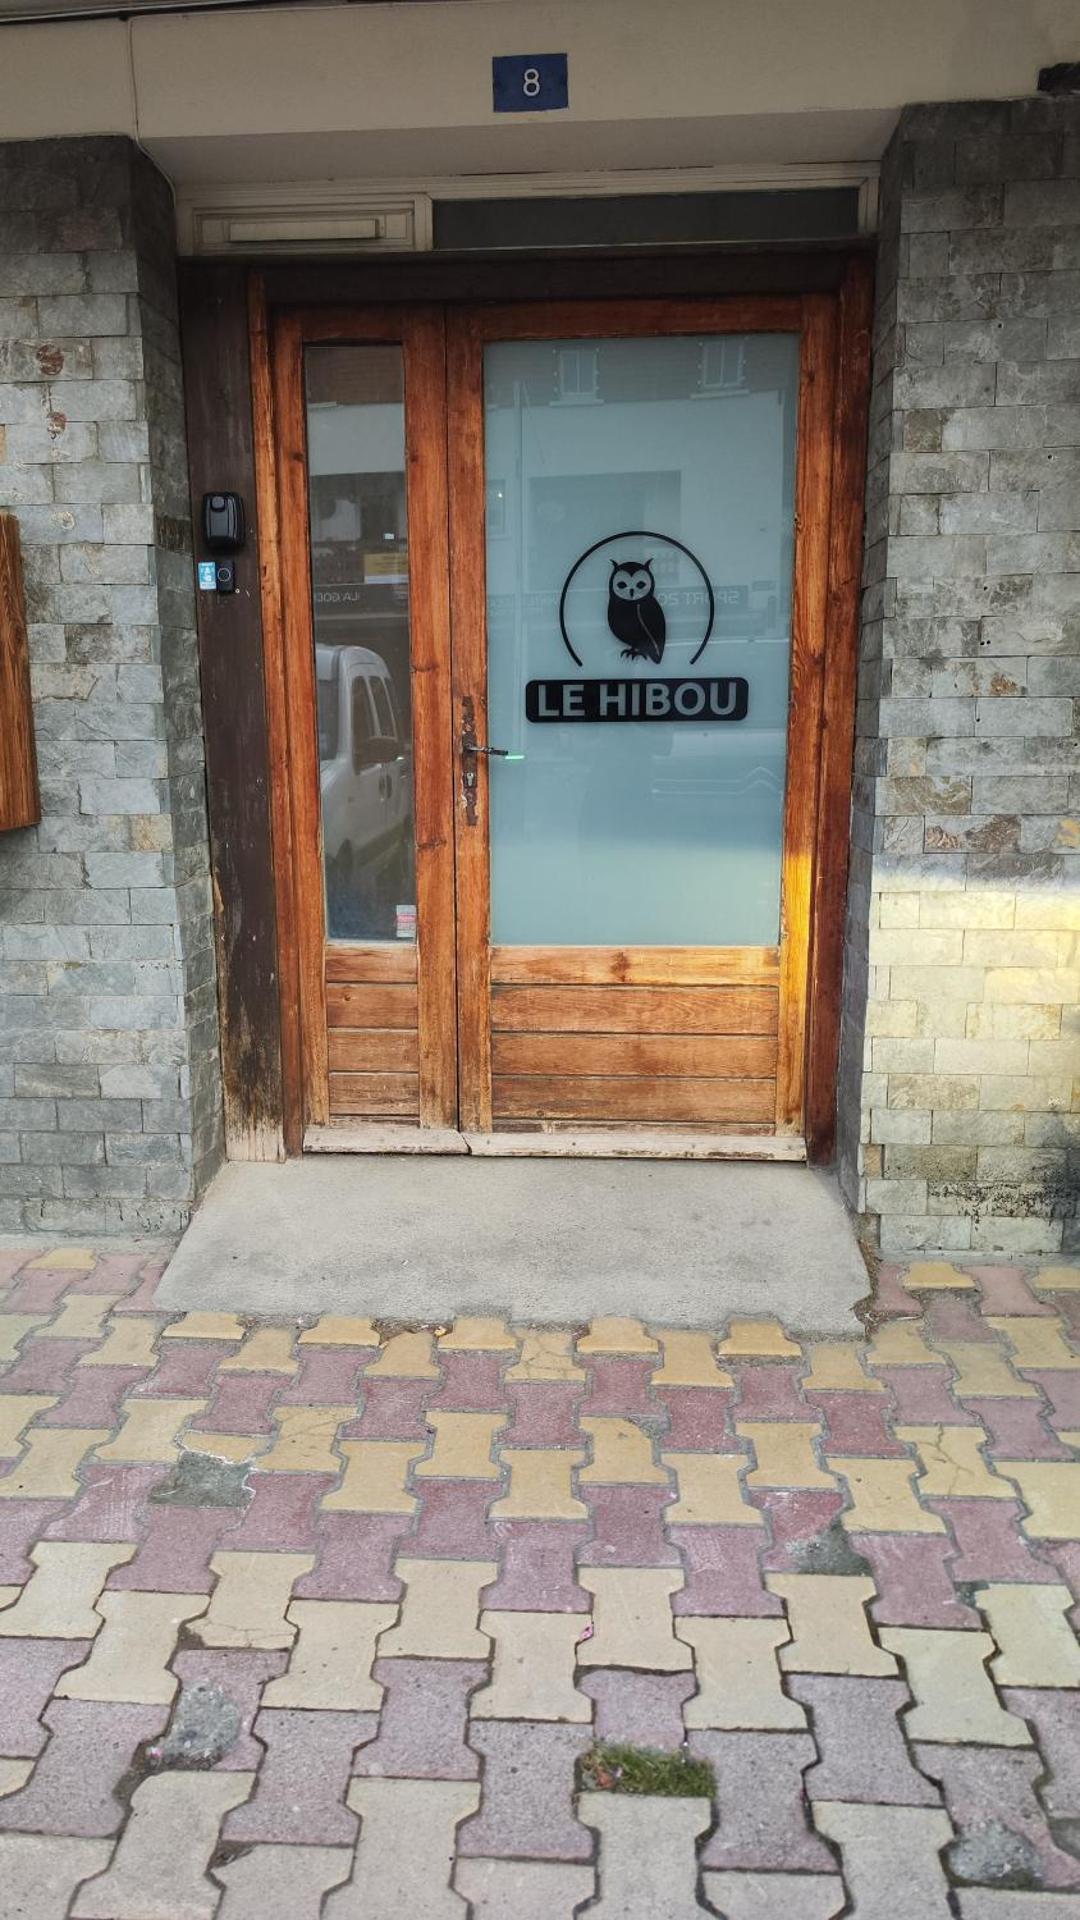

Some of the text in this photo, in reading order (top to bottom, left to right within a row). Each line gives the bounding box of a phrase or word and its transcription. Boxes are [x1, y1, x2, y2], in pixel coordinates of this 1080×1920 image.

[523, 68, 541, 97] 8
[538, 682, 737, 717] LE HIBOU
